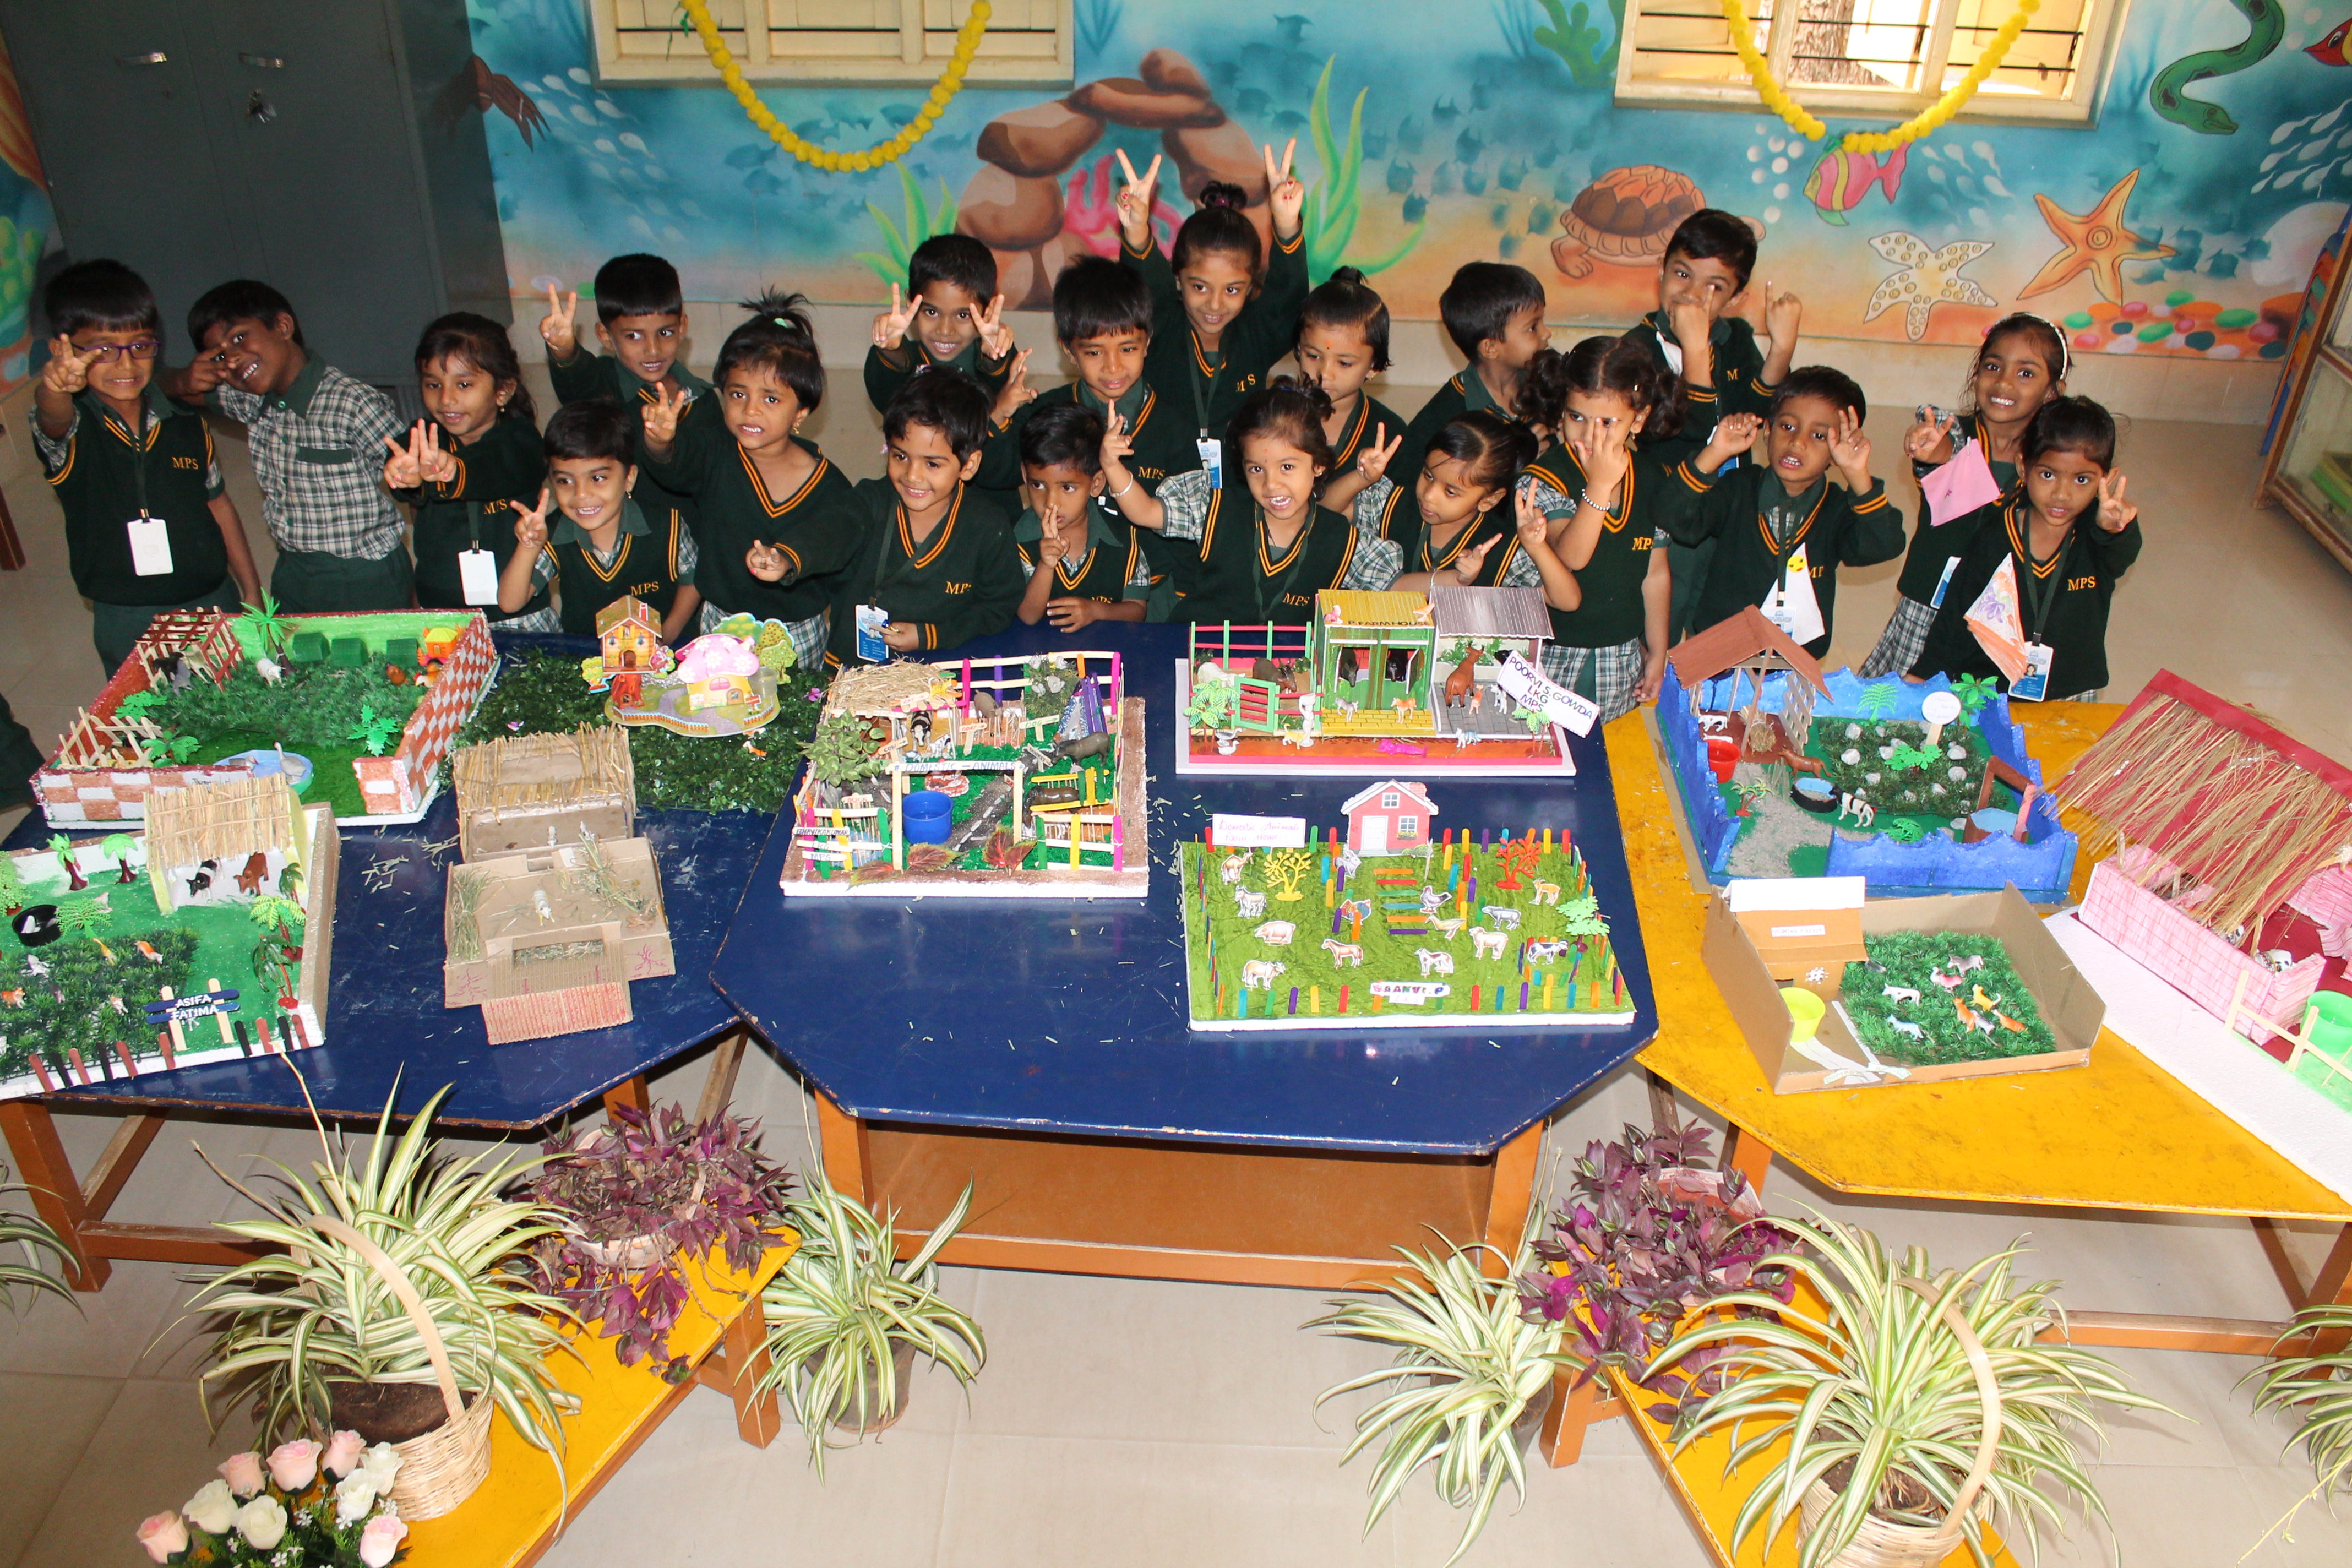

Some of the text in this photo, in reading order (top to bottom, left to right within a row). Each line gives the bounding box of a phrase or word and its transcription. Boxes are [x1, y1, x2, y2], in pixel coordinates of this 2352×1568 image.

[1235, 374, 1255, 391] MS
[172, 456, 198, 470] MPS
[1138, 466, 1165, 479] MPS
[1632, 537, 1654, 550] MP
[630, 581, 659, 596] MPS
[2067, 576, 2096, 591] MPS
[1282, 592, 1310, 606] MPS
[1509, 656, 1543, 688] POORVI
[1527, 685, 1548, 704] LKG
[1520, 694, 1544, 712] MPS
[905, 762, 957, 771] DOMESTIC
[972, 761, 1016, 770] ANIMALS
[1219, 819, 1256, 831] Domestic
[175, 994, 213, 1008] ASIFA
[170, 1004, 220, 1020] FATIMA
